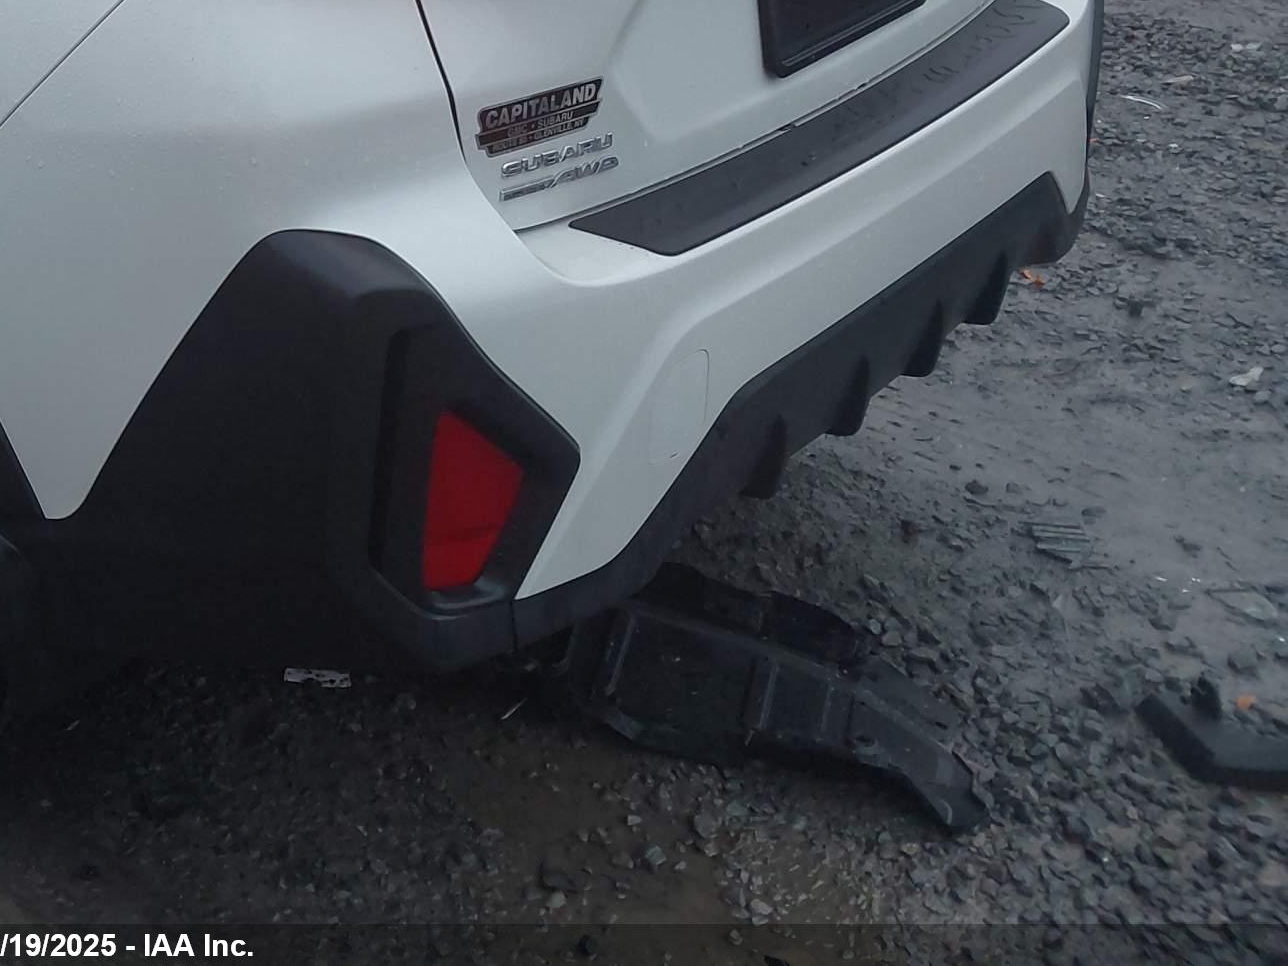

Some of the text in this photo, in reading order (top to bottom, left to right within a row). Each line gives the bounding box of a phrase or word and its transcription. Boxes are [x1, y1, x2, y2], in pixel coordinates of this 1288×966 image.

[485, 83, 596, 129] CAPITALAND
[537, 111, 574, 129] SUBARU
[501, 132, 613, 178] SUBARU
[549, 156, 619, 189] AWD
